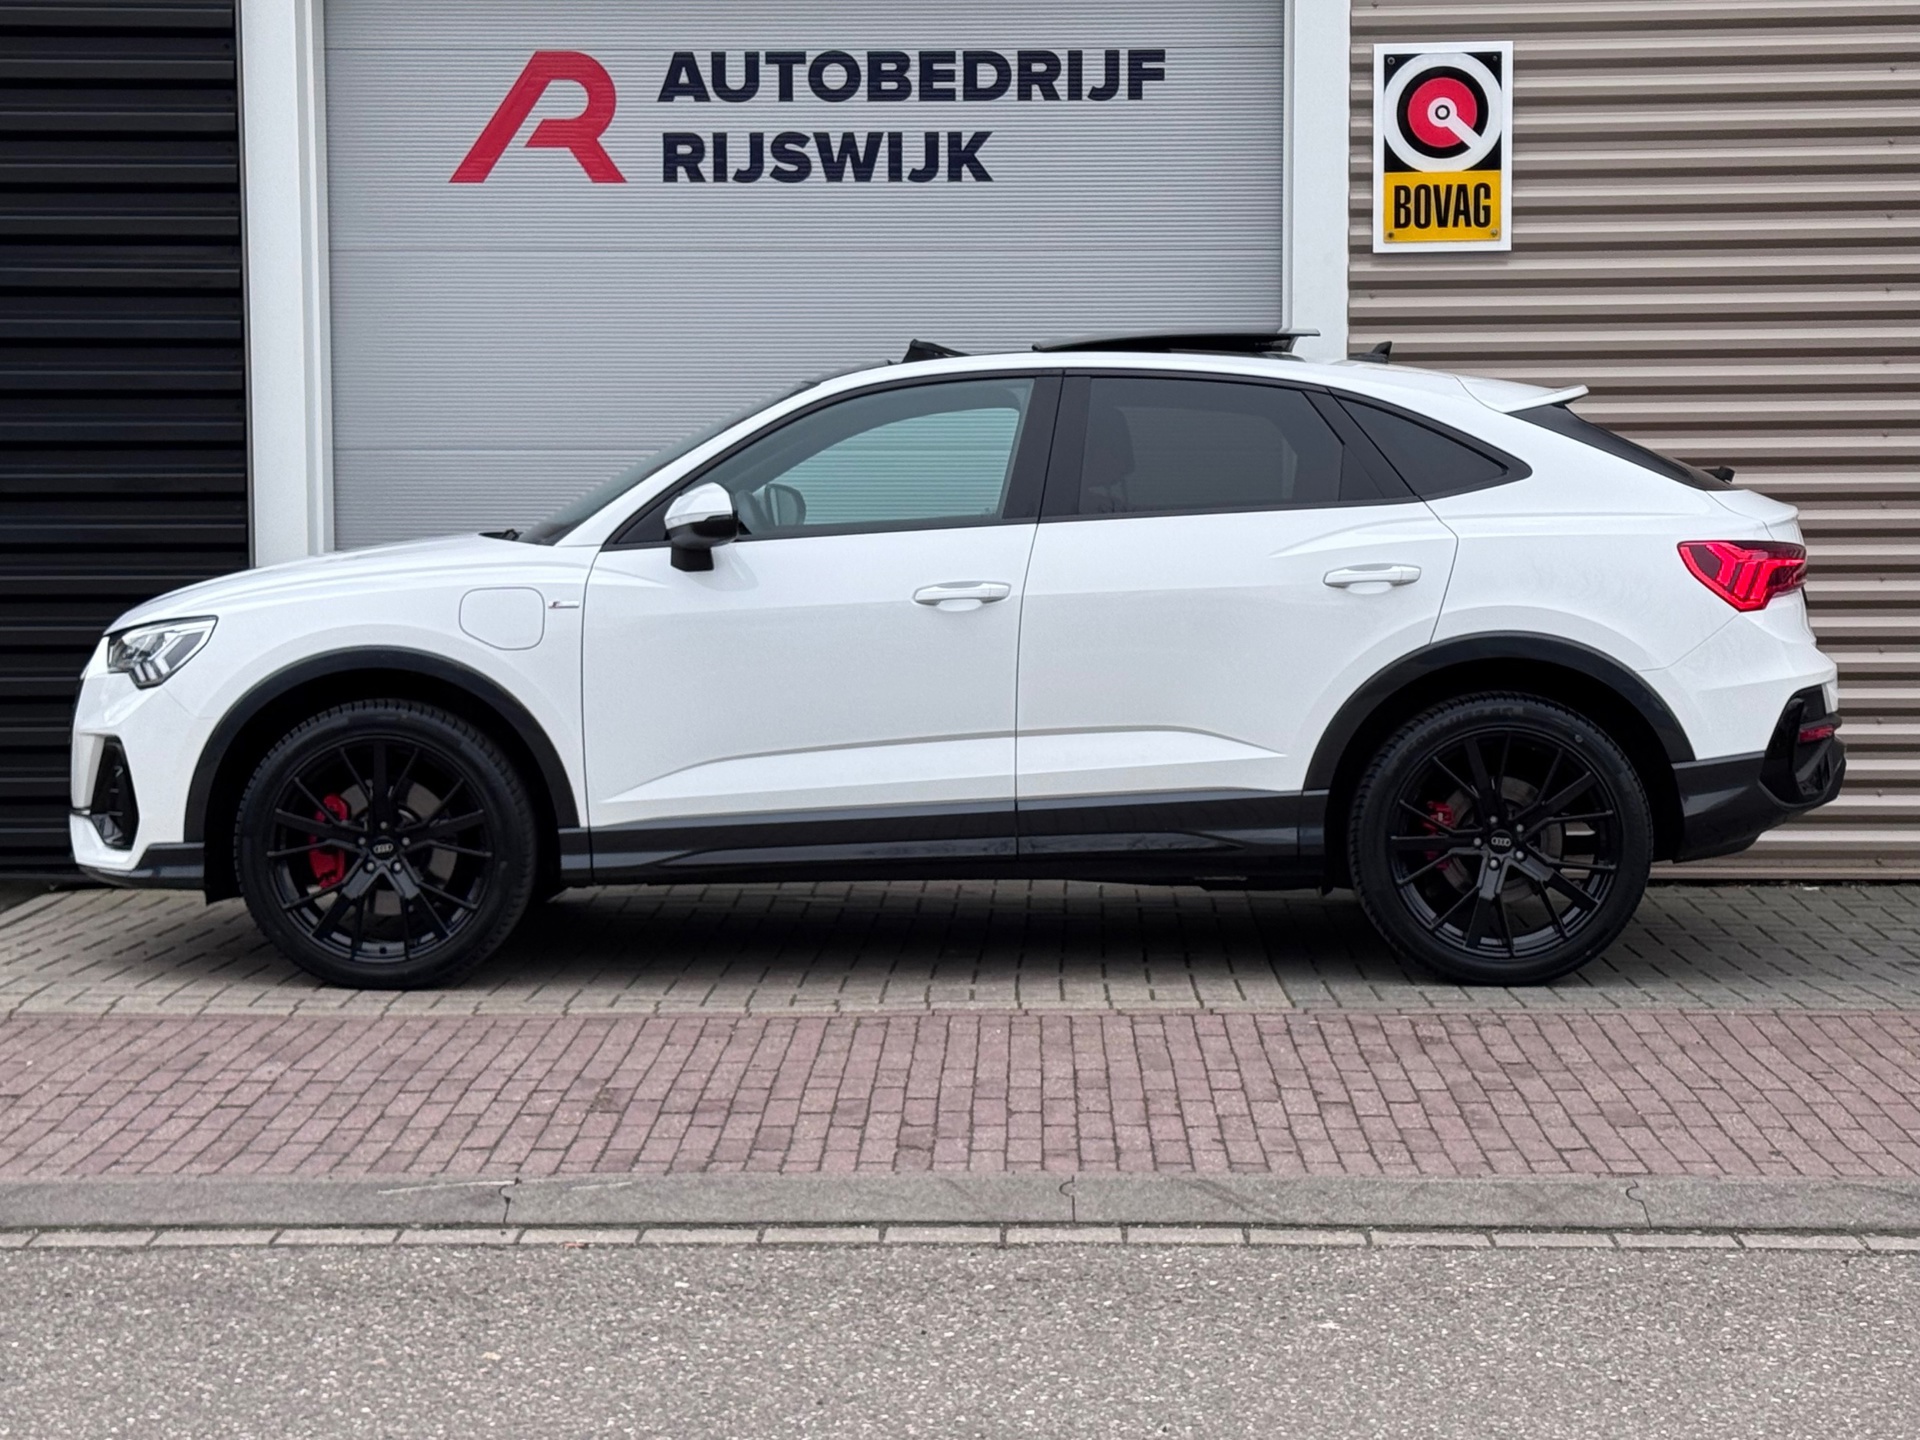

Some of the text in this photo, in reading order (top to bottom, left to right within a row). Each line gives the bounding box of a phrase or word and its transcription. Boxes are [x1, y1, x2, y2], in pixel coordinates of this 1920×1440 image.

[657, 49, 1166, 103] AUTOBEDRIJF
[662, 131, 993, 184] RIJSWIJK
[1393, 183, 1491, 230] BOVAG
